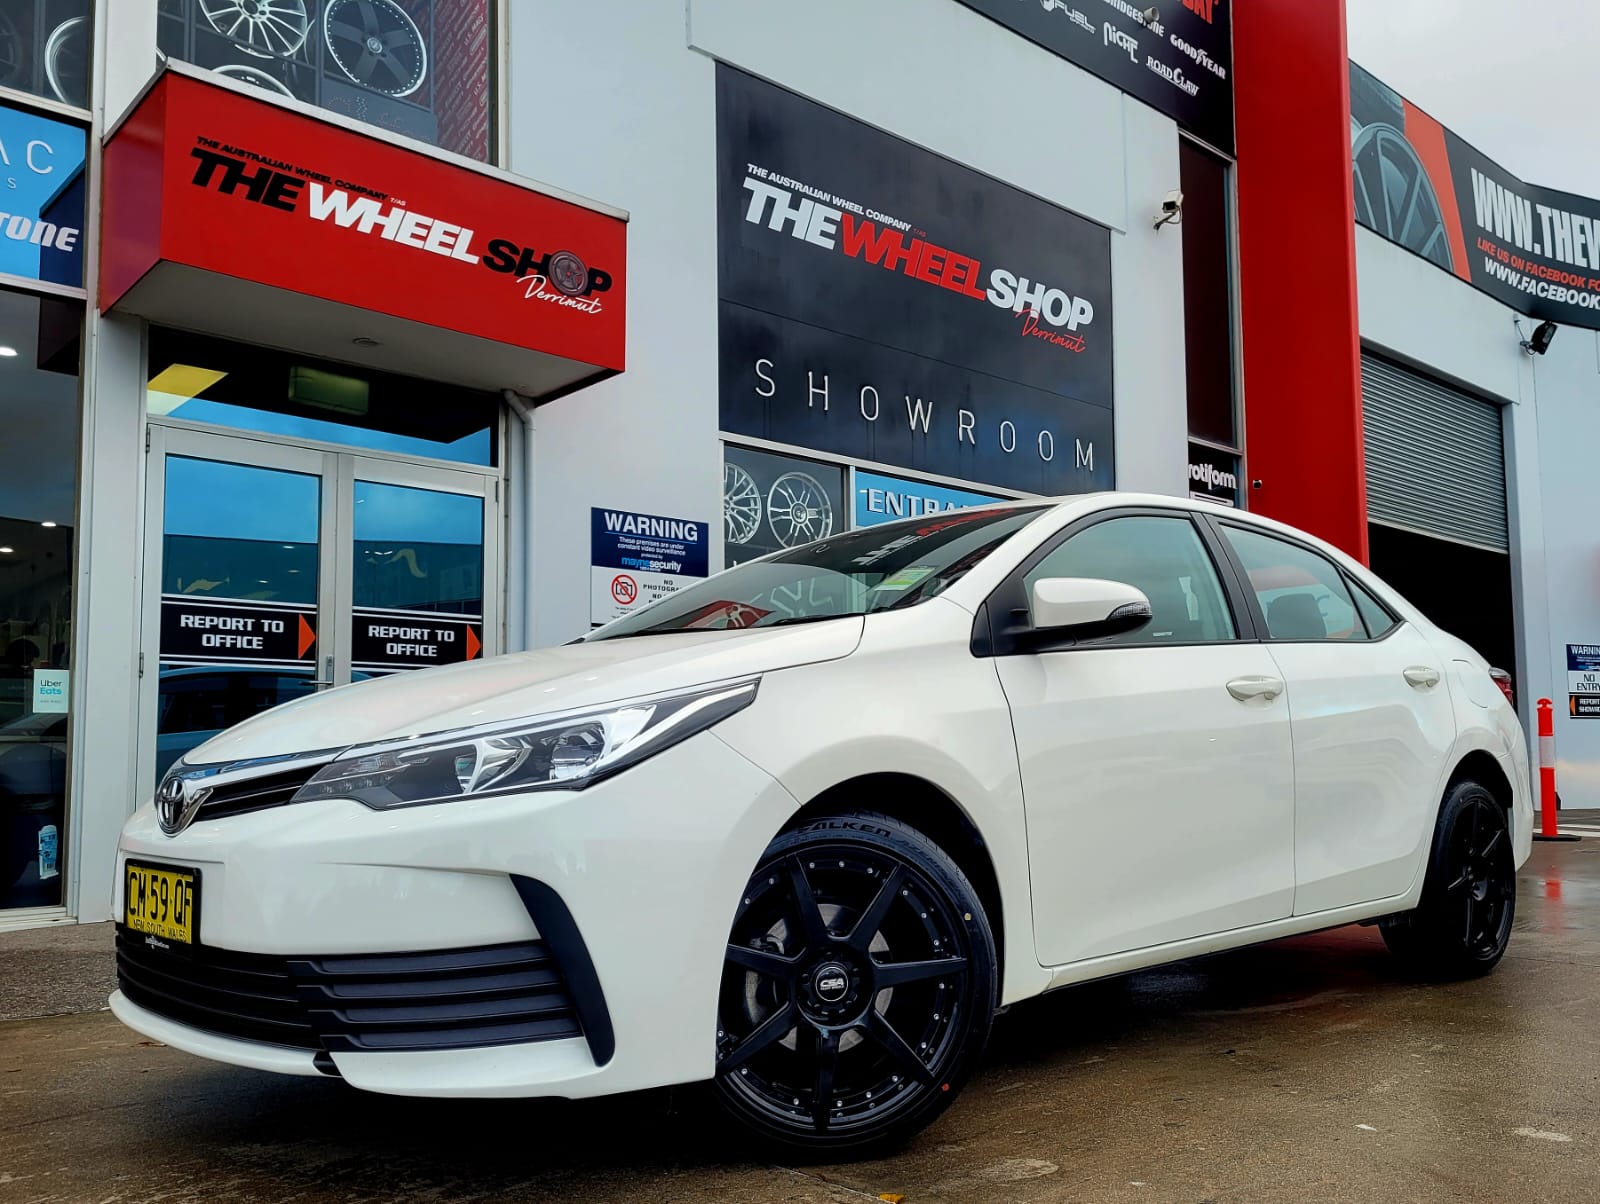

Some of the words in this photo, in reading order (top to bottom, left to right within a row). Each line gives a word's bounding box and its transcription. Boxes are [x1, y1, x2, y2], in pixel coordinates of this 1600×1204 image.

[1103, 0, 1165, 37] RIDGESNE
[1170, 34, 1226, 79] GOODYEAR
[197, 136, 219, 149] THE
[221, 144, 292, 172] AUSTRALIAN
[295, 166, 332, 185] WHEEL
[335, 179, 389, 200] COMPANY
[190, 147, 306, 213] THE
[309, 182, 480, 265] WHEEL
[747, 163, 767, 179] THE
[768, 172, 831, 202] AUSTRALIAN
[832, 195, 864, 215] WHEEL
[866, 208, 912, 232] COMPANY
[742, 176, 842, 250] THE
[842, 212, 987, 301] WHEEL
[986, 269, 1094, 332] SHOP
[1477, 236, 1496, 257] LIKE
[1497, 247, 1510, 264] US
[1510, 255, 1525, 270] ON
[1525, 261, 1586, 288] FACEBOOK
[515, 274, 602, 314] Derrimut
[1014, 308, 1086, 353] Derrimut
[1188, 463, 1237, 490] rotiform
[867, 488, 968, 518] ENTR
[604, 511, 698, 542] WARNING
[618, 543, 640, 551] constant
[656, 547, 686, 556] surveillance
[619, 536, 635, 544] These
[636, 539, 659, 548] premises
[180, 614, 256, 632] REPORT
[261, 619, 284, 634] TO
[368, 624, 430, 641] REPORT
[434, 629, 455, 642] TO
[201, 633, 264, 650] OFFICE
[386, 642, 438, 657] OFFICE
[40, 679, 63, 687] Uber
[40, 687, 63, 695] Eats
[1576, 682, 1600, 691] ENTRY
[1583, 673, 1596, 683] NO
[133, 918, 145, 930] NEW
[146, 921, 165, 936] SOUTH
[167, 926, 187, 941] WALES
